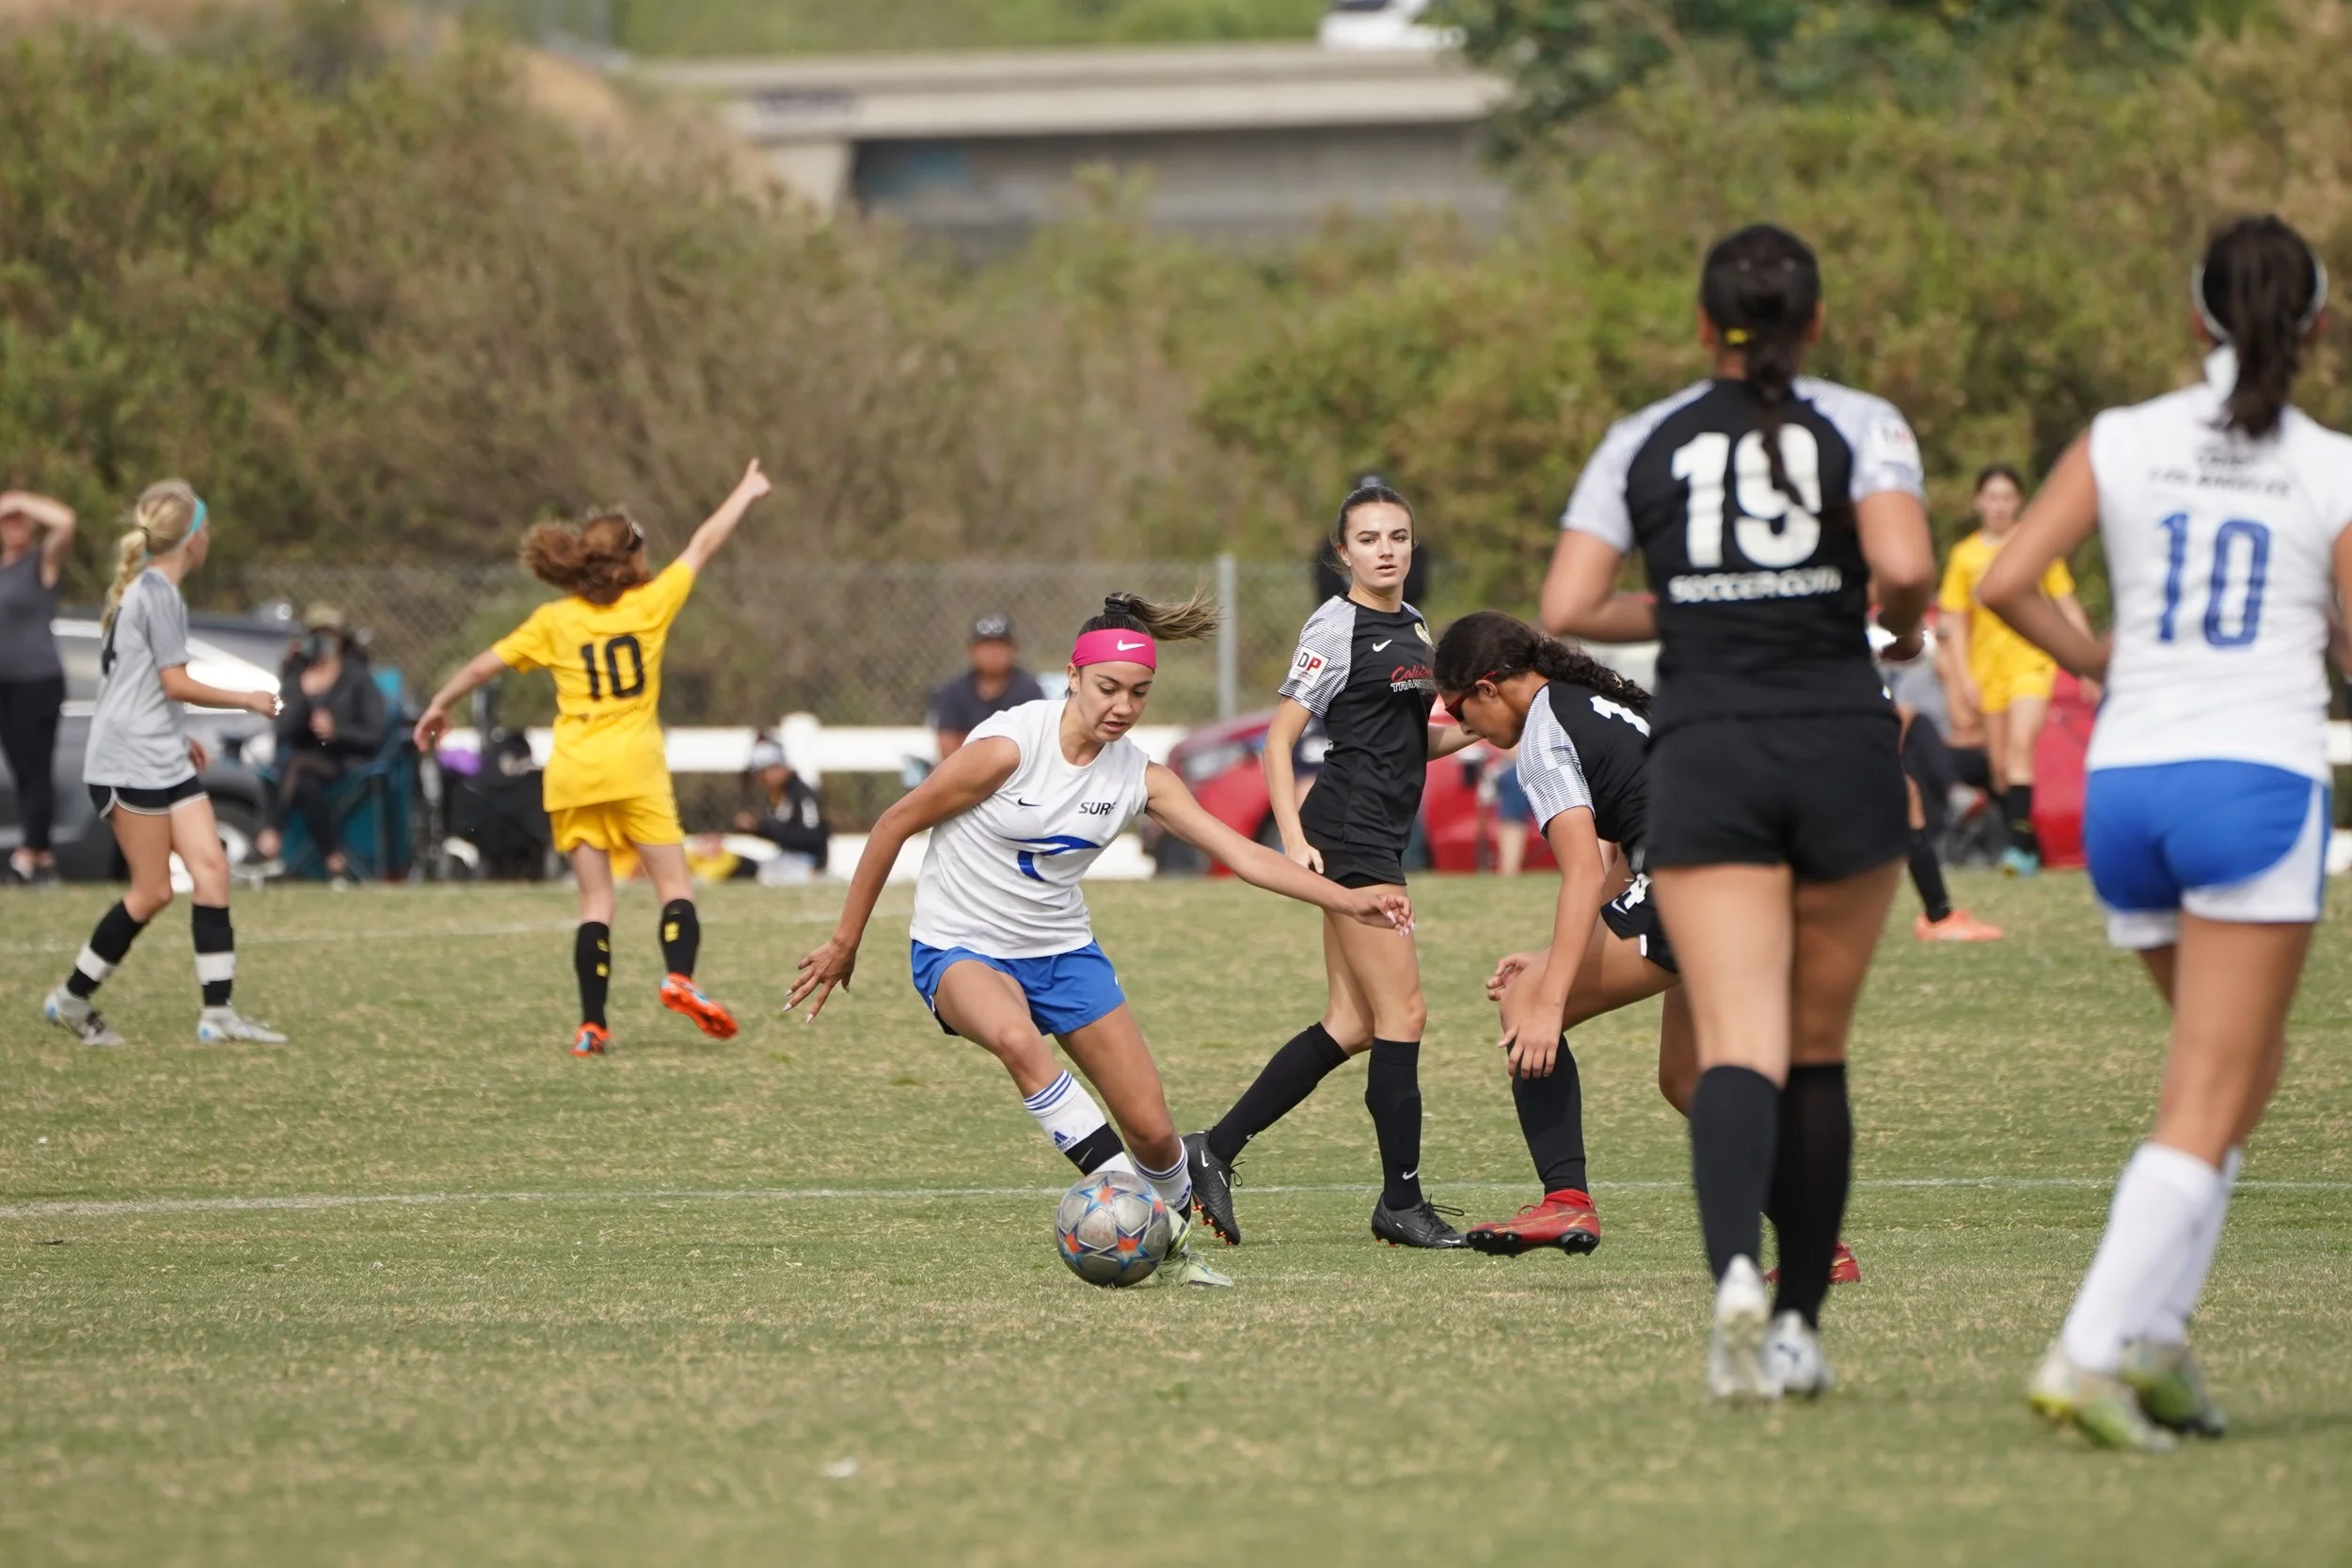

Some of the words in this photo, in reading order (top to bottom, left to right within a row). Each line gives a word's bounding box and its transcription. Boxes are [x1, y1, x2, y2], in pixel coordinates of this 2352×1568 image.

[1672, 422, 1822, 568] 19
[2157, 513, 2270, 646] 10
[580, 634, 644, 702] 10
[1297, 651, 1322, 672] DP
